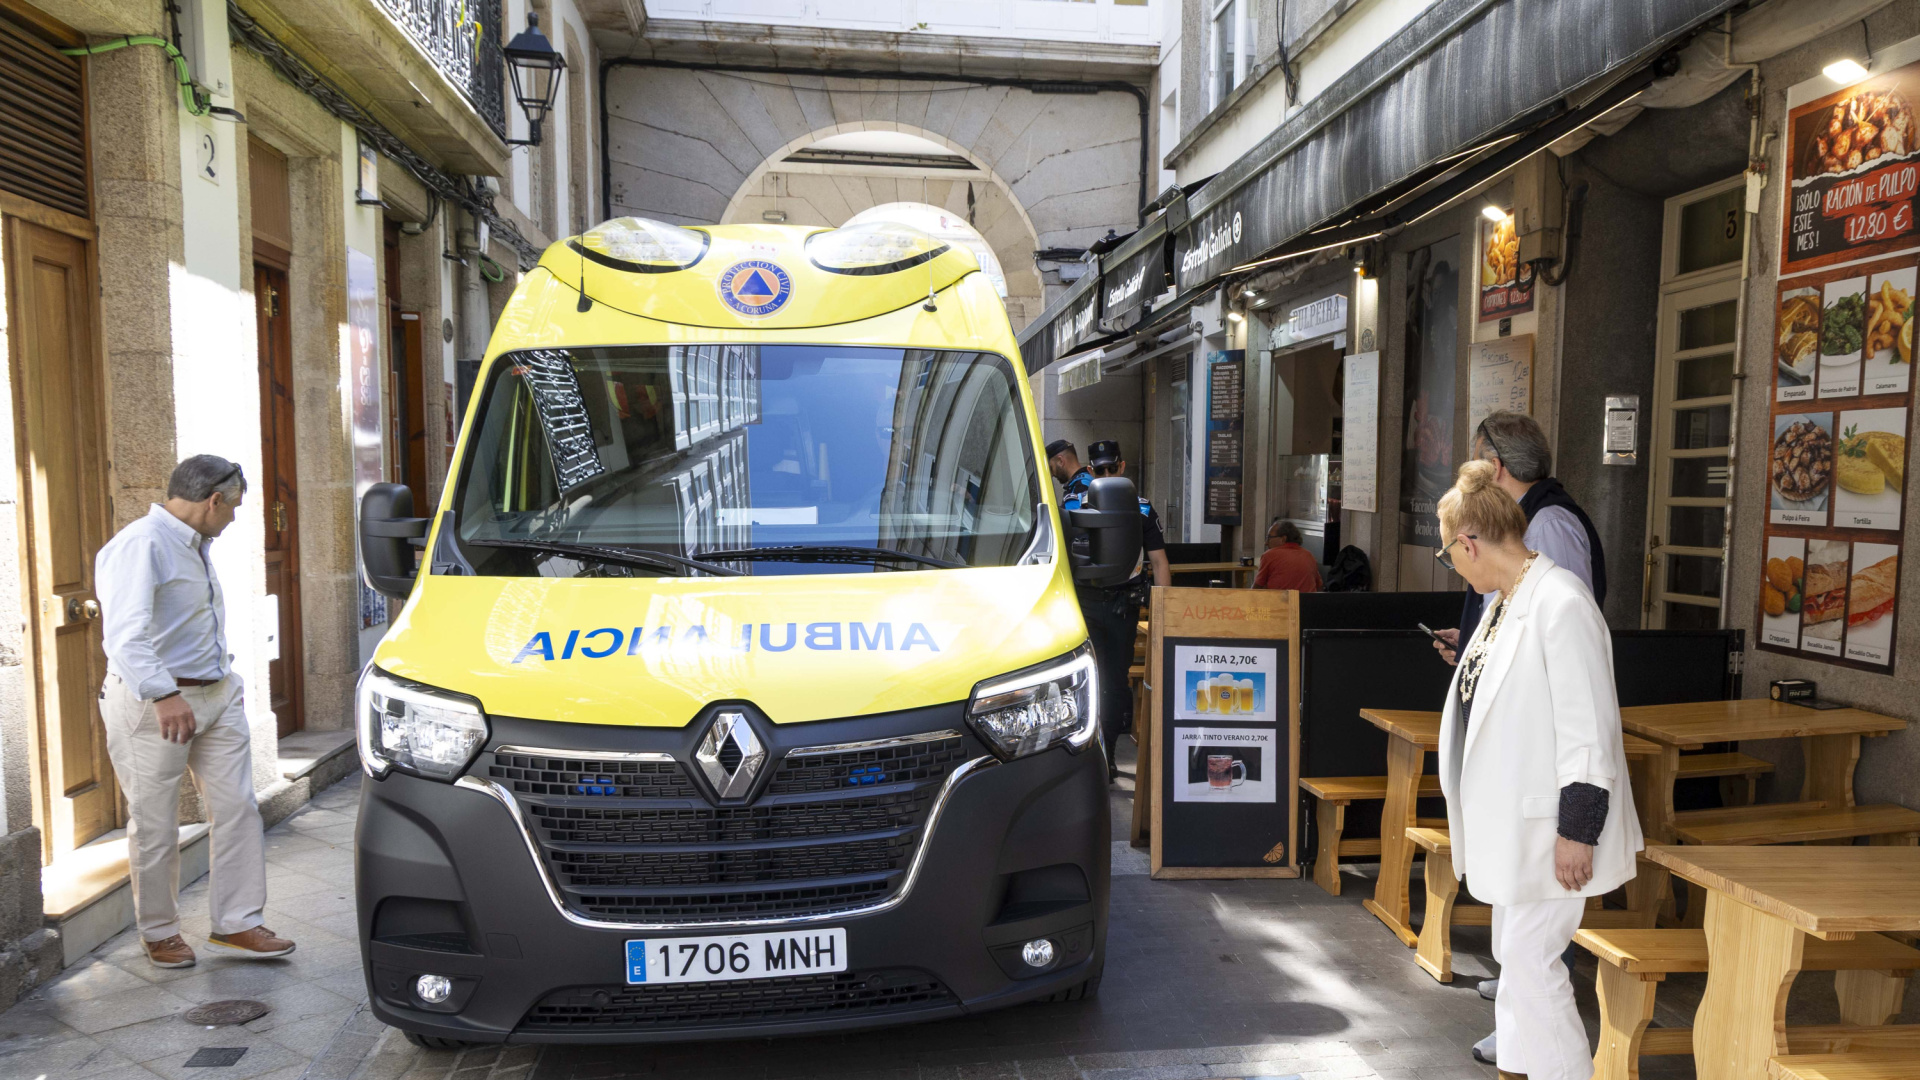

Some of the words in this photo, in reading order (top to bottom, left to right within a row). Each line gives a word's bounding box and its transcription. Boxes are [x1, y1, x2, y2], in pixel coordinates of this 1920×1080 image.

[203, 134, 215, 178] 2
[1825, 180, 1864, 213] RACIÓN
[1865, 184, 1877, 202] DE
[1878, 166, 1917, 199] PULPO
[1726, 210, 1737, 240] 3
[1793, 211, 1815, 233] ESTE
[1849, 212, 1887, 242] 12,80
[1181, 239, 1209, 273] Estrella
[1208, 221, 1232, 259] Galicia
[776, 271, 790, 295] CIVIL
[1292, 295, 1340, 333] PULPEIRA
[1782, 514, 1795, 522] Pulpo
[1799, 514, 1811, 522] Feira
[1853, 517, 1872, 525] Tortilla
[1182, 605, 1245, 621] AUARA
[1194, 654, 1227, 664] JARRA
[1229, 655, 1258, 666] 2,70€
[659, 942, 750, 977] 1706
[764, 935, 836, 972] MNH
[633, 966, 642, 976] E
